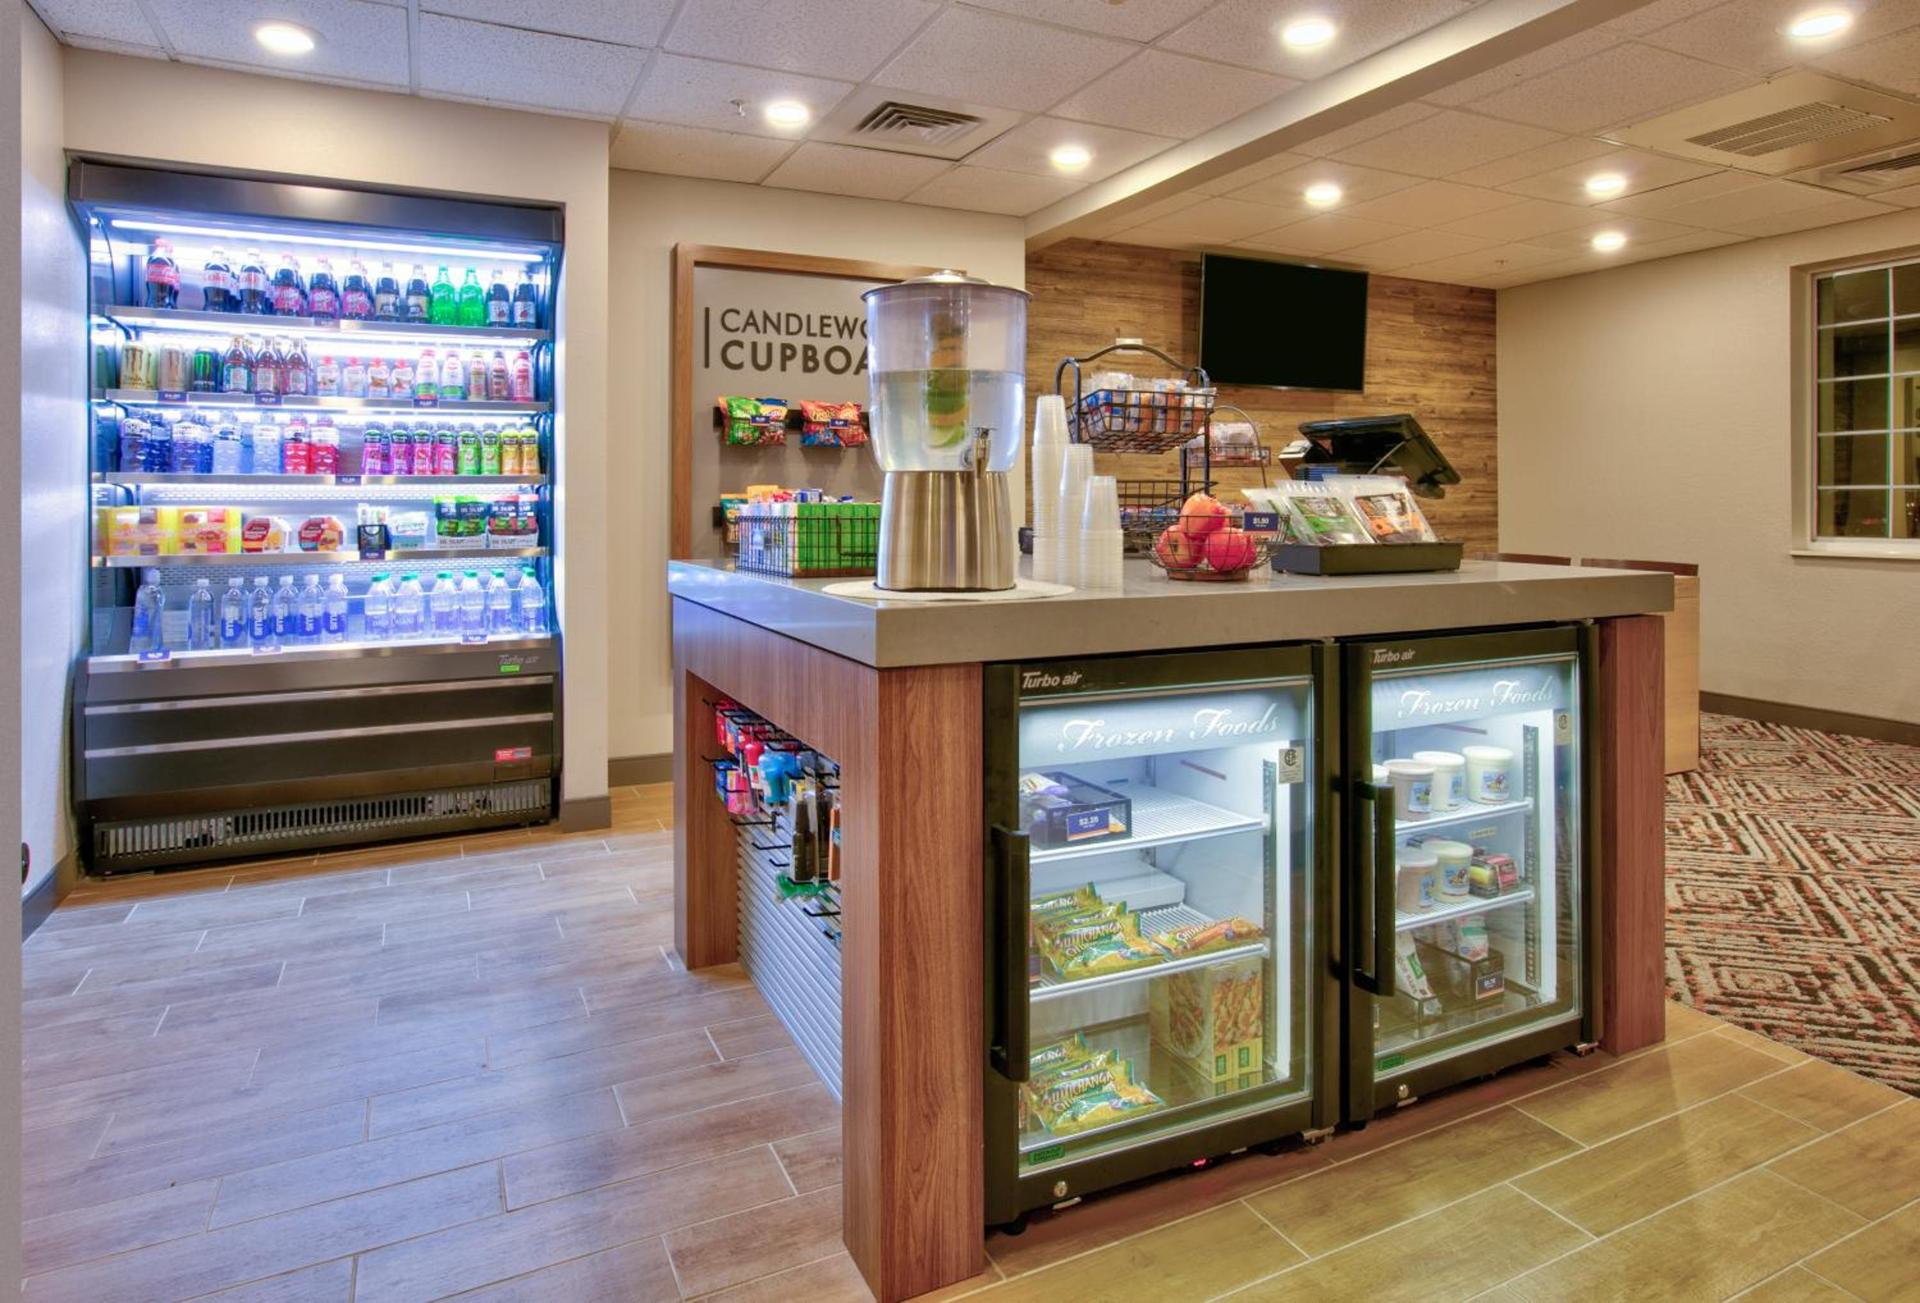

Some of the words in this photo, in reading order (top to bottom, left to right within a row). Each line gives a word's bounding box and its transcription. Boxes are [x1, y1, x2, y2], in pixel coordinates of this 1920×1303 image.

[1373, 649, 1400, 664] Turbo
[1022, 671, 1061, 689] Turbo
[1062, 671, 1083, 686] air
[1398, 690, 1481, 718] Frozen
[1490, 675, 1554, 707] Foods
[1057, 719, 1176, 752] Frozen
[1189, 703, 1279, 740] Foods
